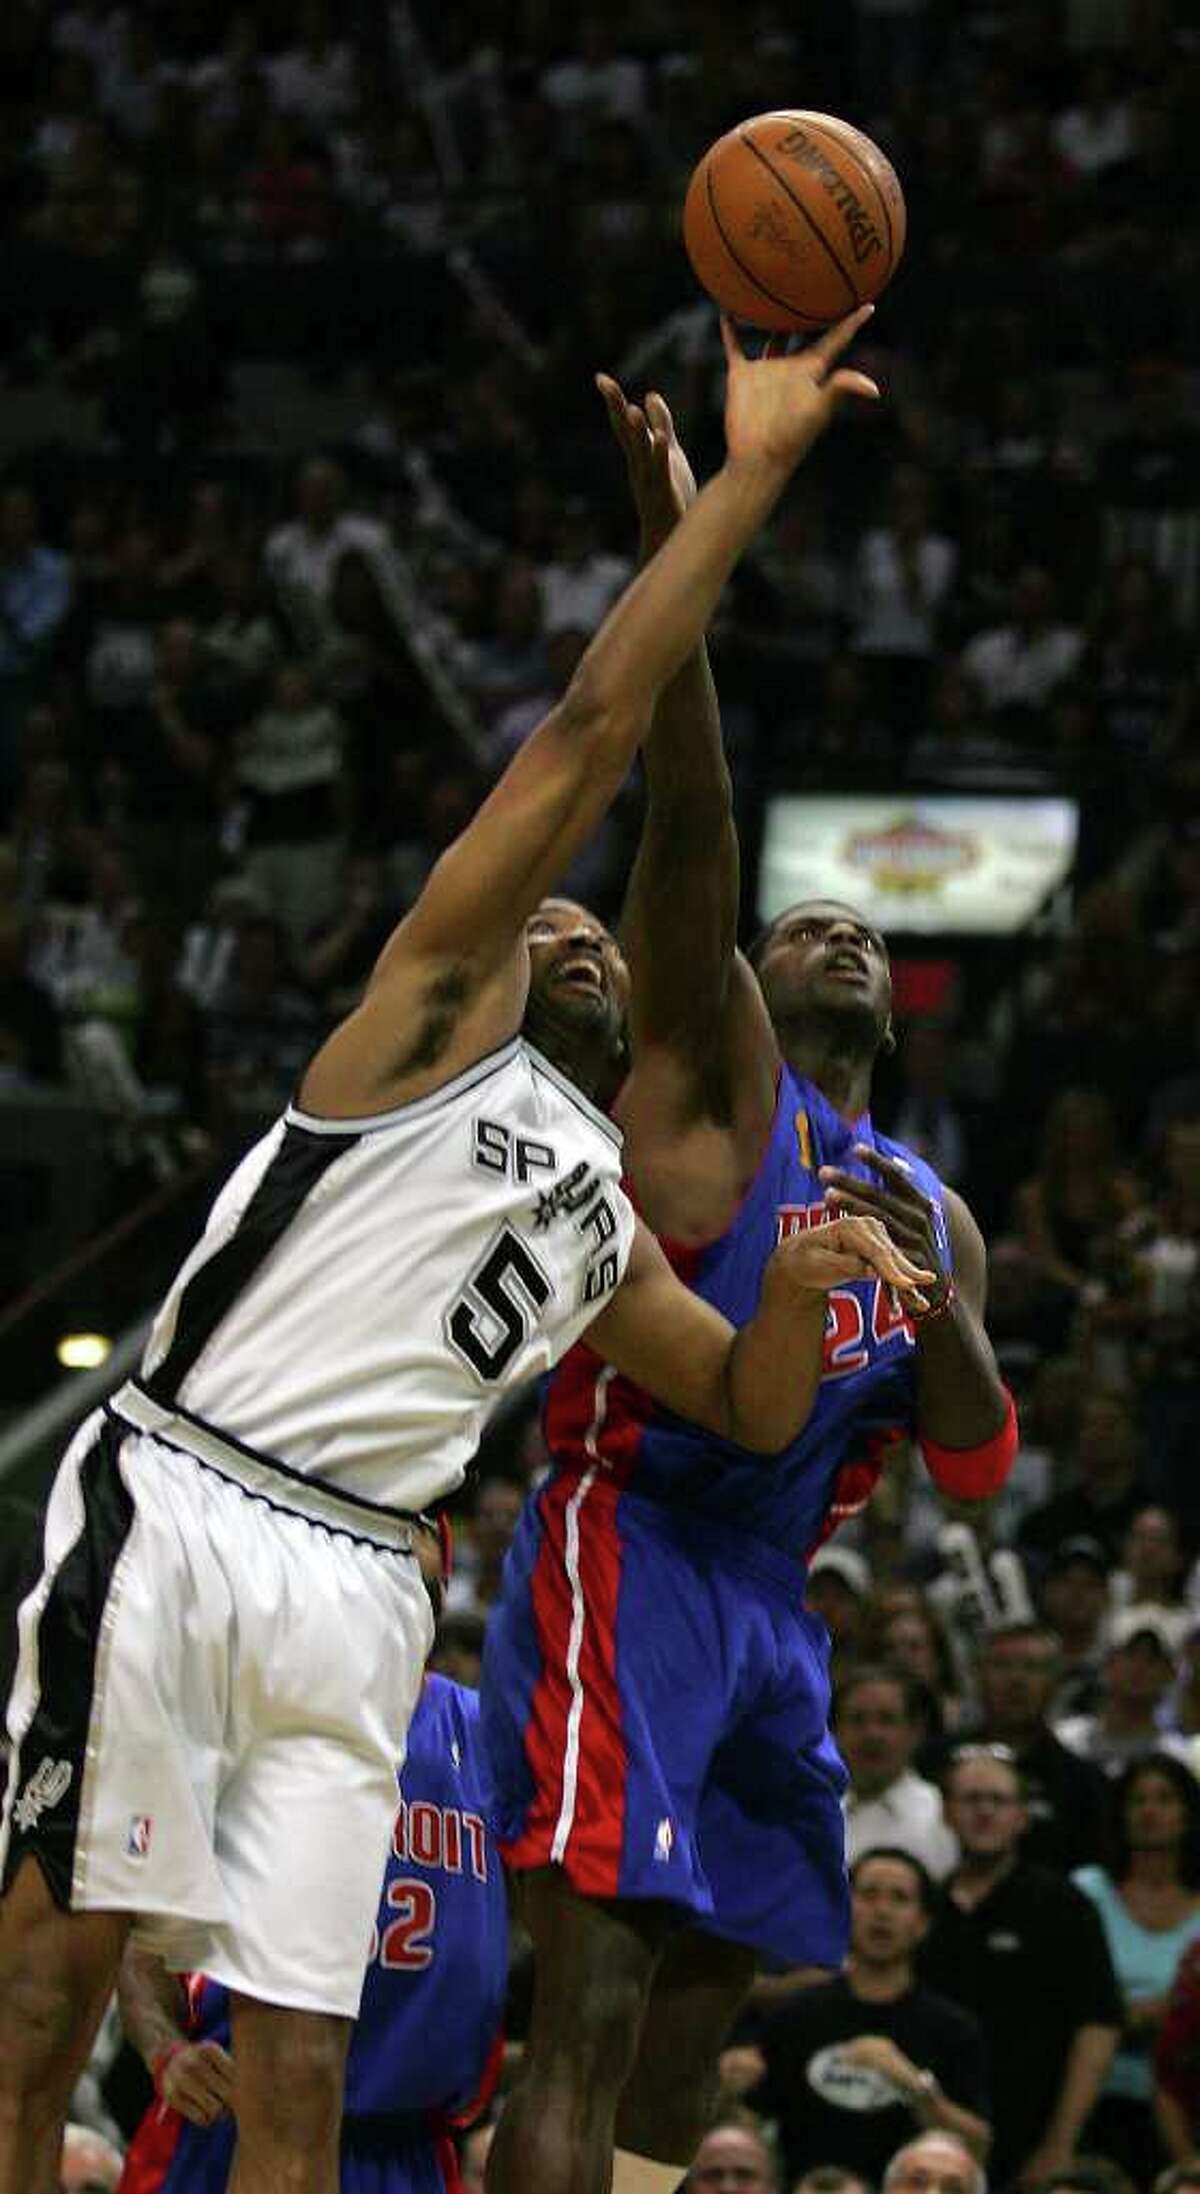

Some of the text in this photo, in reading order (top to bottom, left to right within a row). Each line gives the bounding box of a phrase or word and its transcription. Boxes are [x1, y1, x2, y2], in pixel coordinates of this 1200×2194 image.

[779, 127, 882, 263] SPALDING
[473, 1116, 620, 1302] SPURS
[444, 1220, 556, 1382] 5
[820, 1278, 918, 1381] 24
[371, 1878, 436, 1970] 2
